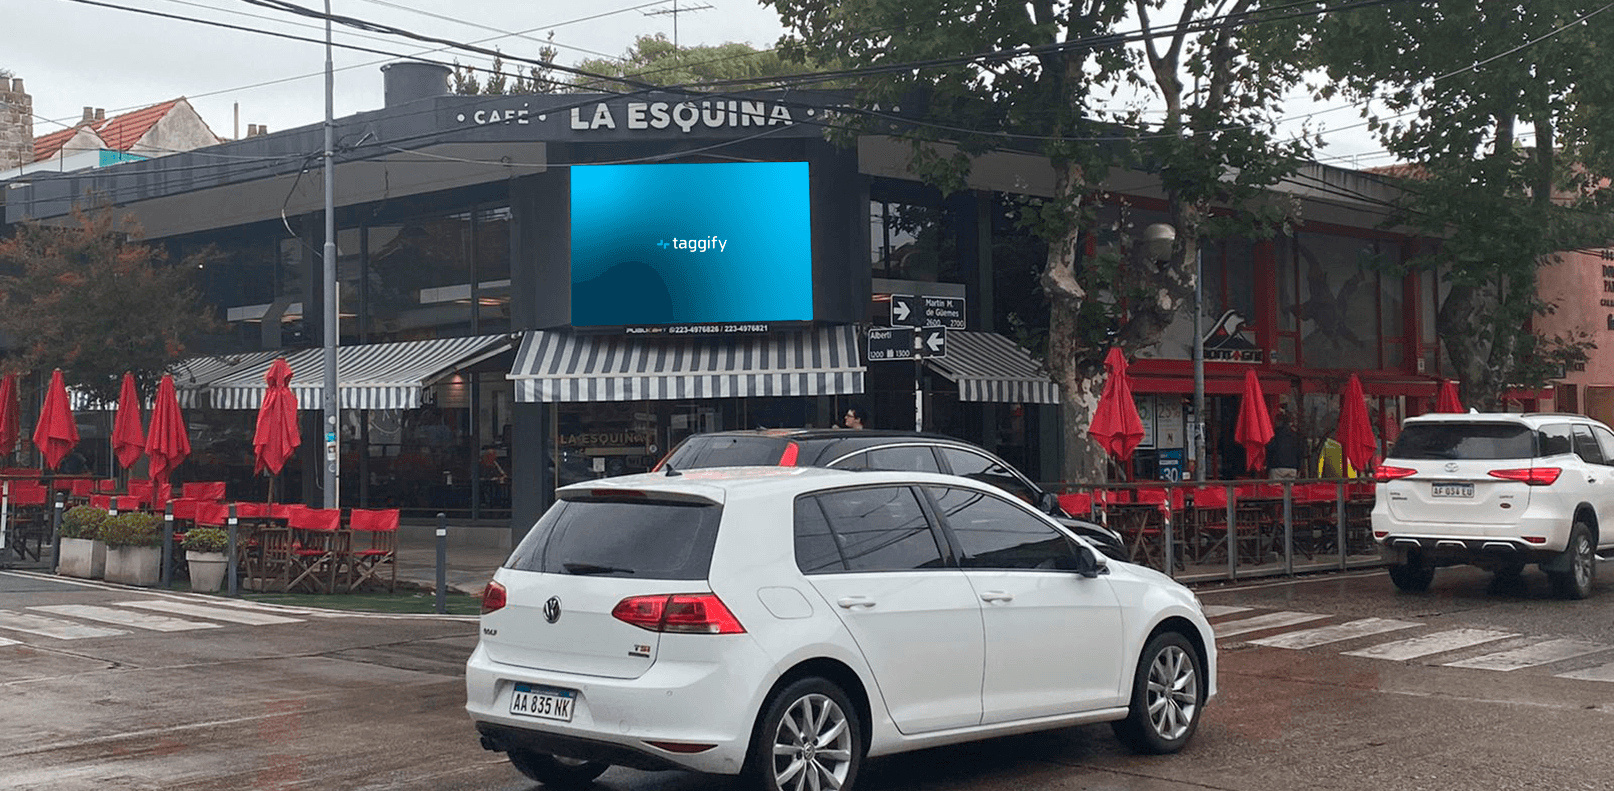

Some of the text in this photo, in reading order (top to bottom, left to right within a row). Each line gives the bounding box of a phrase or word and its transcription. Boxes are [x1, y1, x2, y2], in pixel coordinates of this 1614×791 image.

[570, 103, 615, 129] LA
[627, 99, 793, 132] ESQUINA
[672, 235, 728, 252] taggify
[925, 308, 934, 317] de
[870, 331, 892, 340] Alberti
[560, 435, 577, 445] LA
[513, 693, 571, 718] AA 835 NK
